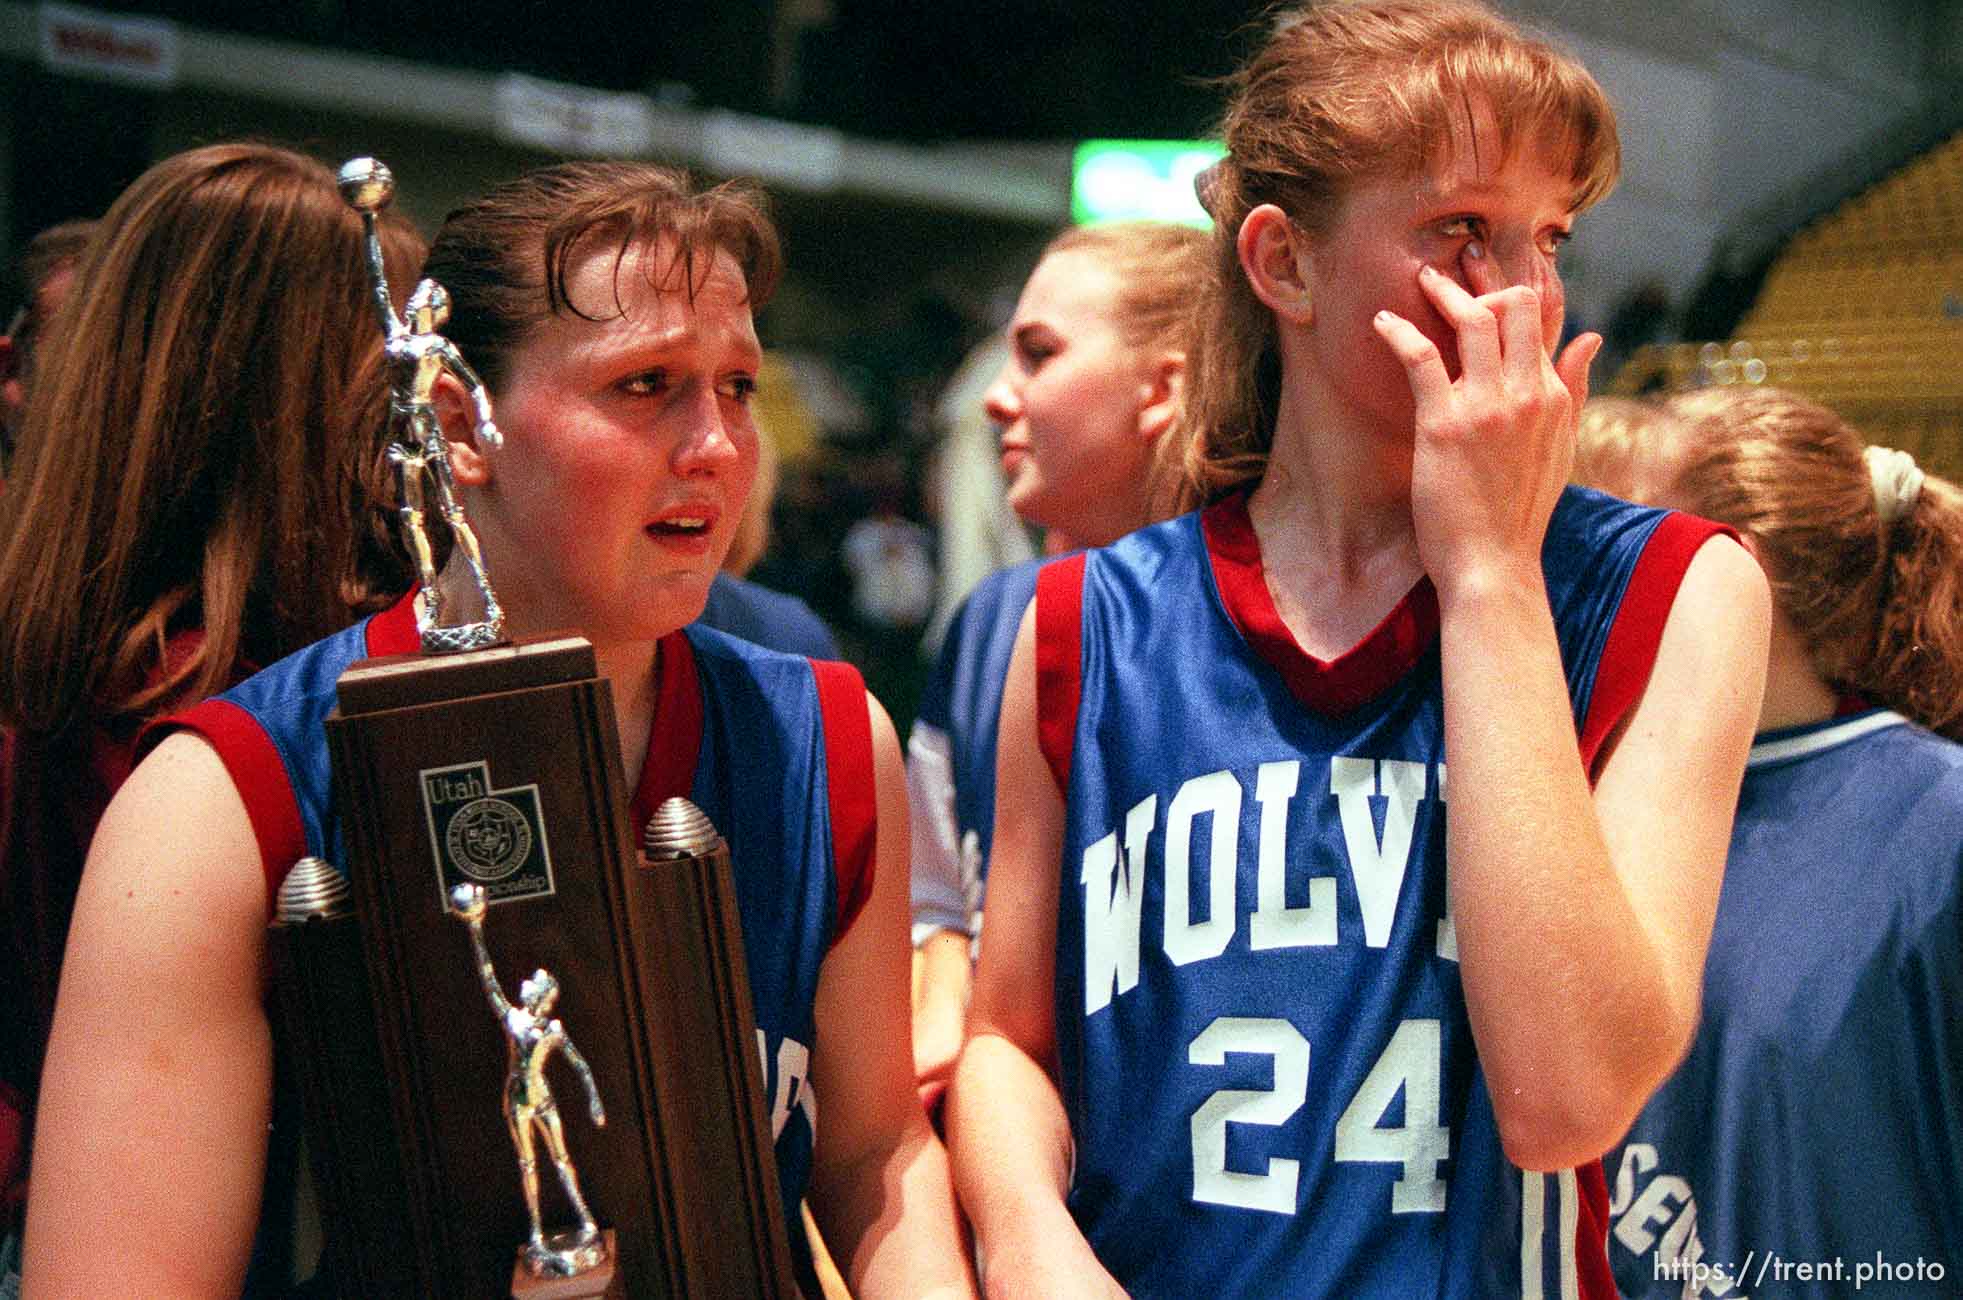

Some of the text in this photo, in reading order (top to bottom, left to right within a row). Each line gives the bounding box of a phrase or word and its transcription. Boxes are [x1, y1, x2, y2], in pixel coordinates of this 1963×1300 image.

[427, 771, 484, 805] Utah
[1080, 756, 1459, 1017] WOLV
[1188, 1017, 1450, 1215] 24
